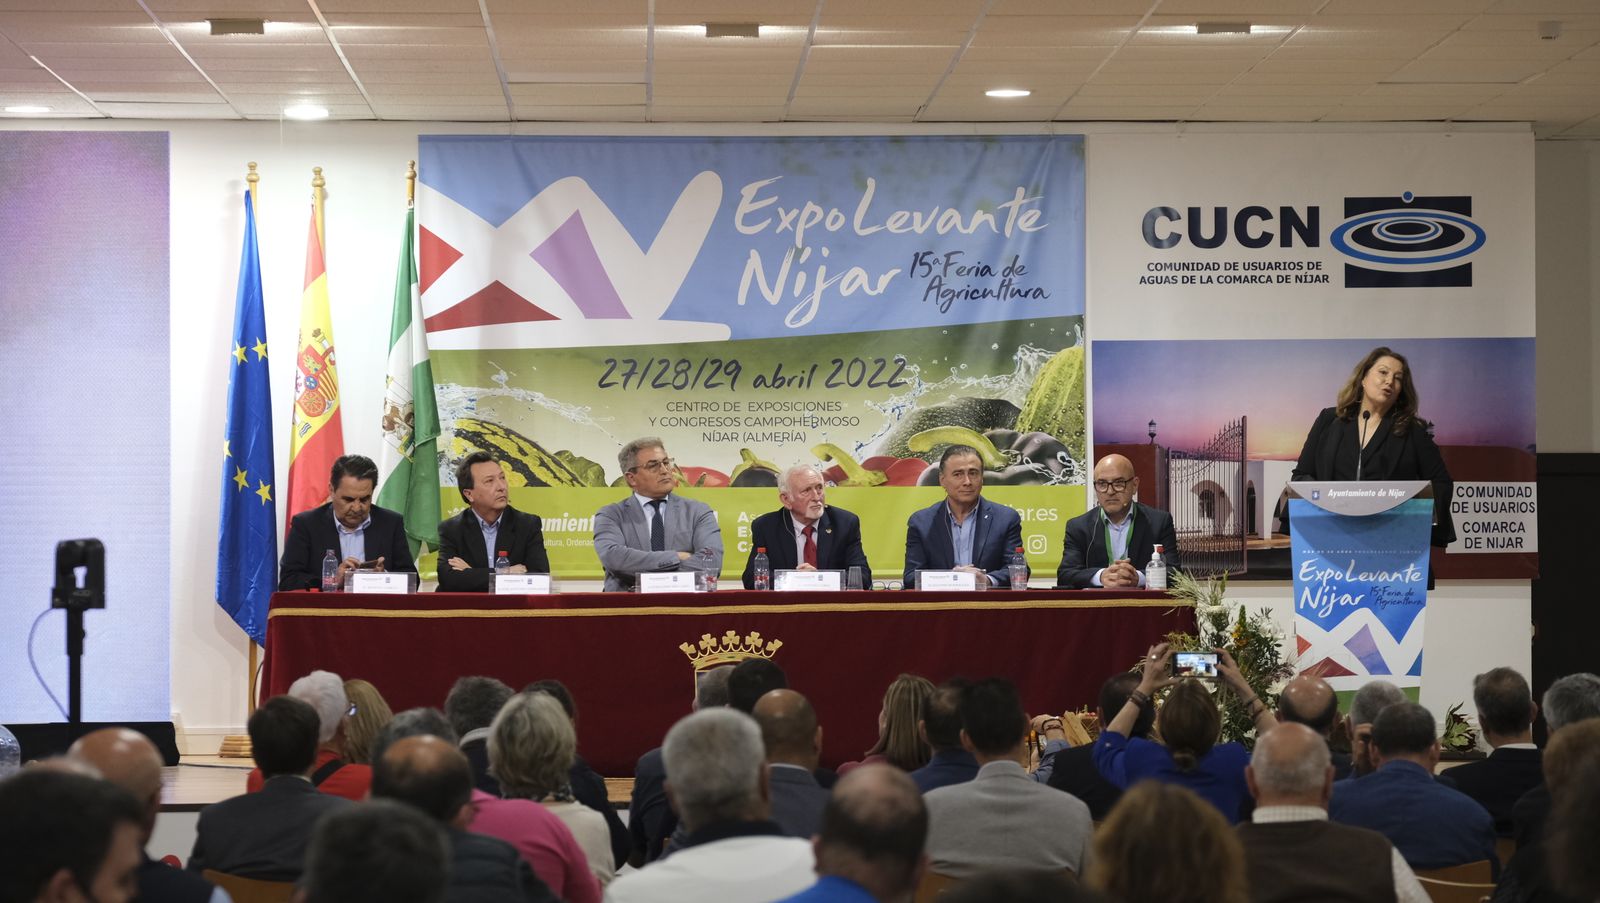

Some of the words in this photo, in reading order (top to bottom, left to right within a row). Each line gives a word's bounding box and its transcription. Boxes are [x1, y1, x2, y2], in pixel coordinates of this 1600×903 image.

[1141, 205, 1320, 249] CUCN
[943, 250, 997, 278] Feria
[1001, 254, 1029, 277] de
[1147, 262, 1221, 272] COMUNIDAD
[1224, 262, 1239, 271] DE
[1242, 261, 1304, 271] USUARIOS
[1307, 261, 1322, 271] DE
[1139, 275, 1178, 285] AGUAS
[1181, 275, 1197, 285] DE
[1200, 275, 1213, 284] LA
[1216, 275, 1273, 284] COMARCA
[1276, 274, 1292, 284] DE
[1295, 272, 1330, 283] NÍJAR
[737, 247, 901, 328] Níjar
[922, 274, 1051, 314] Agricultura
[598, 357, 742, 392] 27/28/29
[752, 362, 818, 390] abril
[824, 356, 908, 389] 2022
[666, 401, 720, 413] CENTRO
[723, 401, 741, 412] DE
[748, 401, 842, 412] EXPOSICIONES
[648, 417, 657, 428] Y
[659, 416, 741, 428] CONGRESOS
[744, 416, 860, 428] CAMPOHERMOSO
[702, 430, 739, 443] NÍJAR
[742, 430, 807, 443] (ALMERÍA)
[1328, 489, 1376, 499] Ayuntamiento
[1377, 488, 1387, 497] de
[1456, 486, 1532, 498] COMUNIDAD
[1452, 501, 1469, 513] DE
[1473, 501, 1536, 513] USUARIOS
[1462, 521, 1526, 533] COMARCA
[1464, 537, 1482, 549] DE
[1486, 537, 1524, 549] NIJAR
[1299, 585, 1365, 618] Níjar
